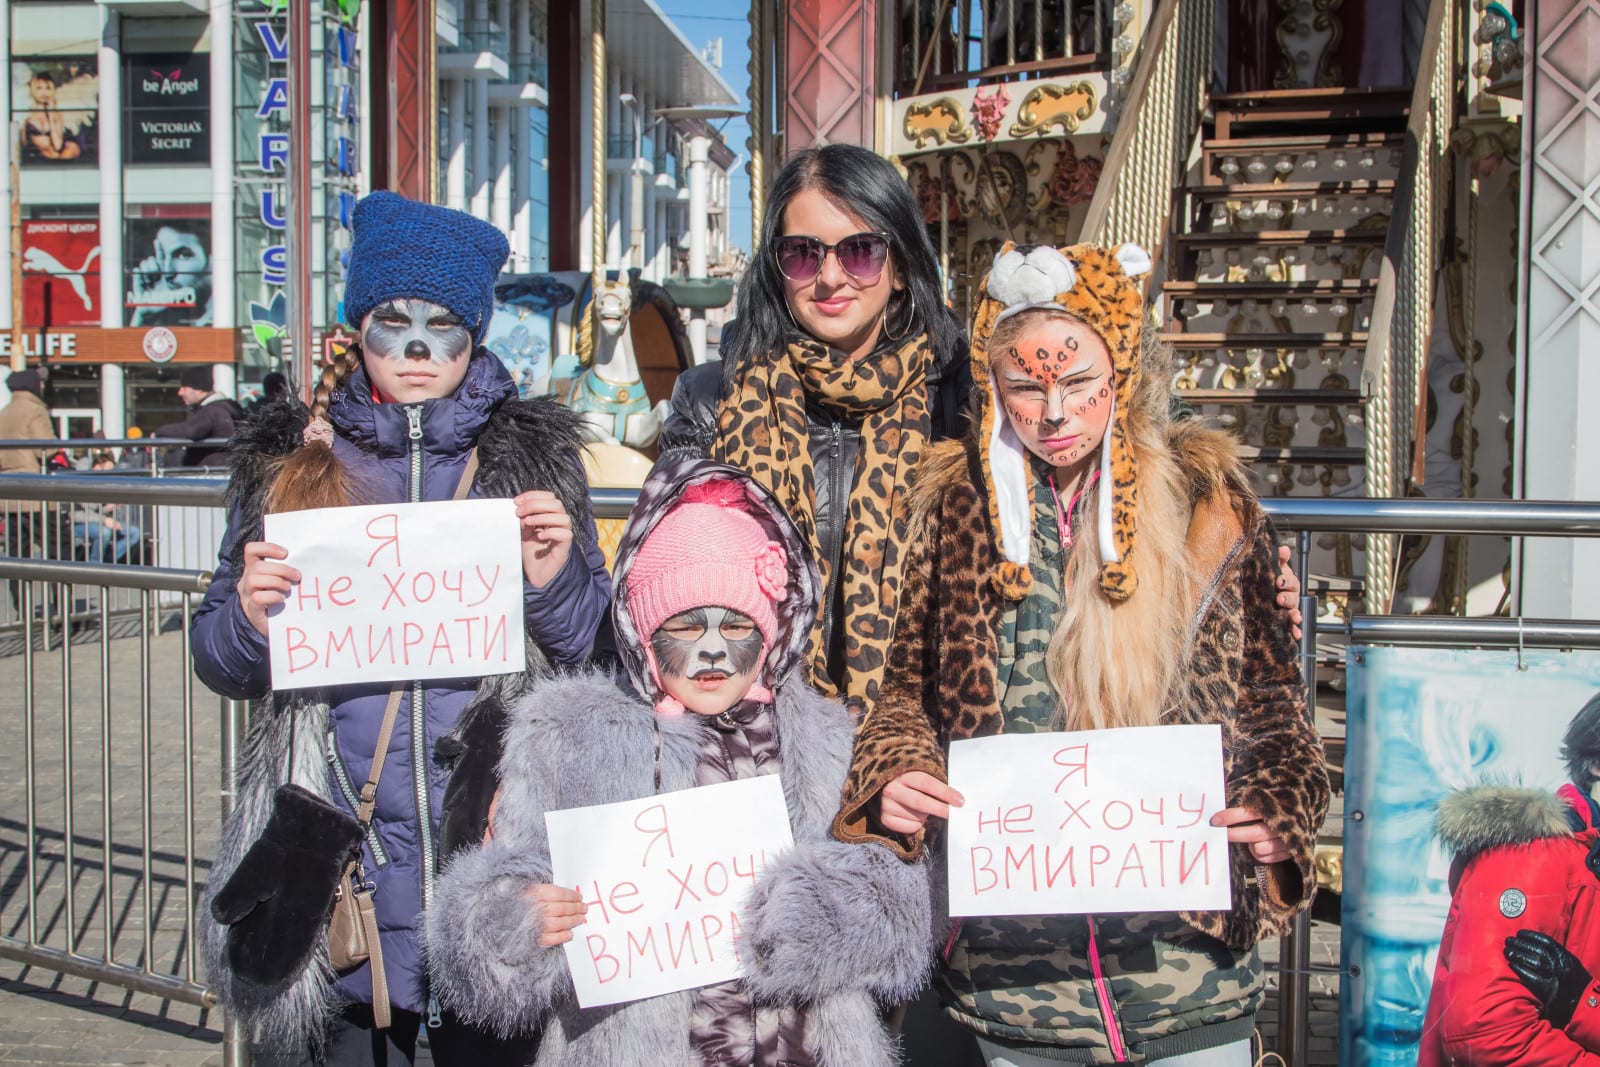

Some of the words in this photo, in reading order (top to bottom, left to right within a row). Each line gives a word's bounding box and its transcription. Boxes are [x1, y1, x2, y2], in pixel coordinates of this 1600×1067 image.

[143, 79, 159, 92] be
[161, 78, 198, 95] Angel
[141, 121, 202, 133] VICTORIA'S
[151, 138, 192, 149] SECRET
[21, 333, 77, 356] LIFE
[366, 514, 401, 567] Я
[286, 614, 507, 673] ВМИРАТИ
[1053, 743, 1088, 793] Я
[634, 804, 674, 867] Я
[971, 841, 1209, 895] ВМИРАТИ
[586, 911, 746, 984] ВМИРА
